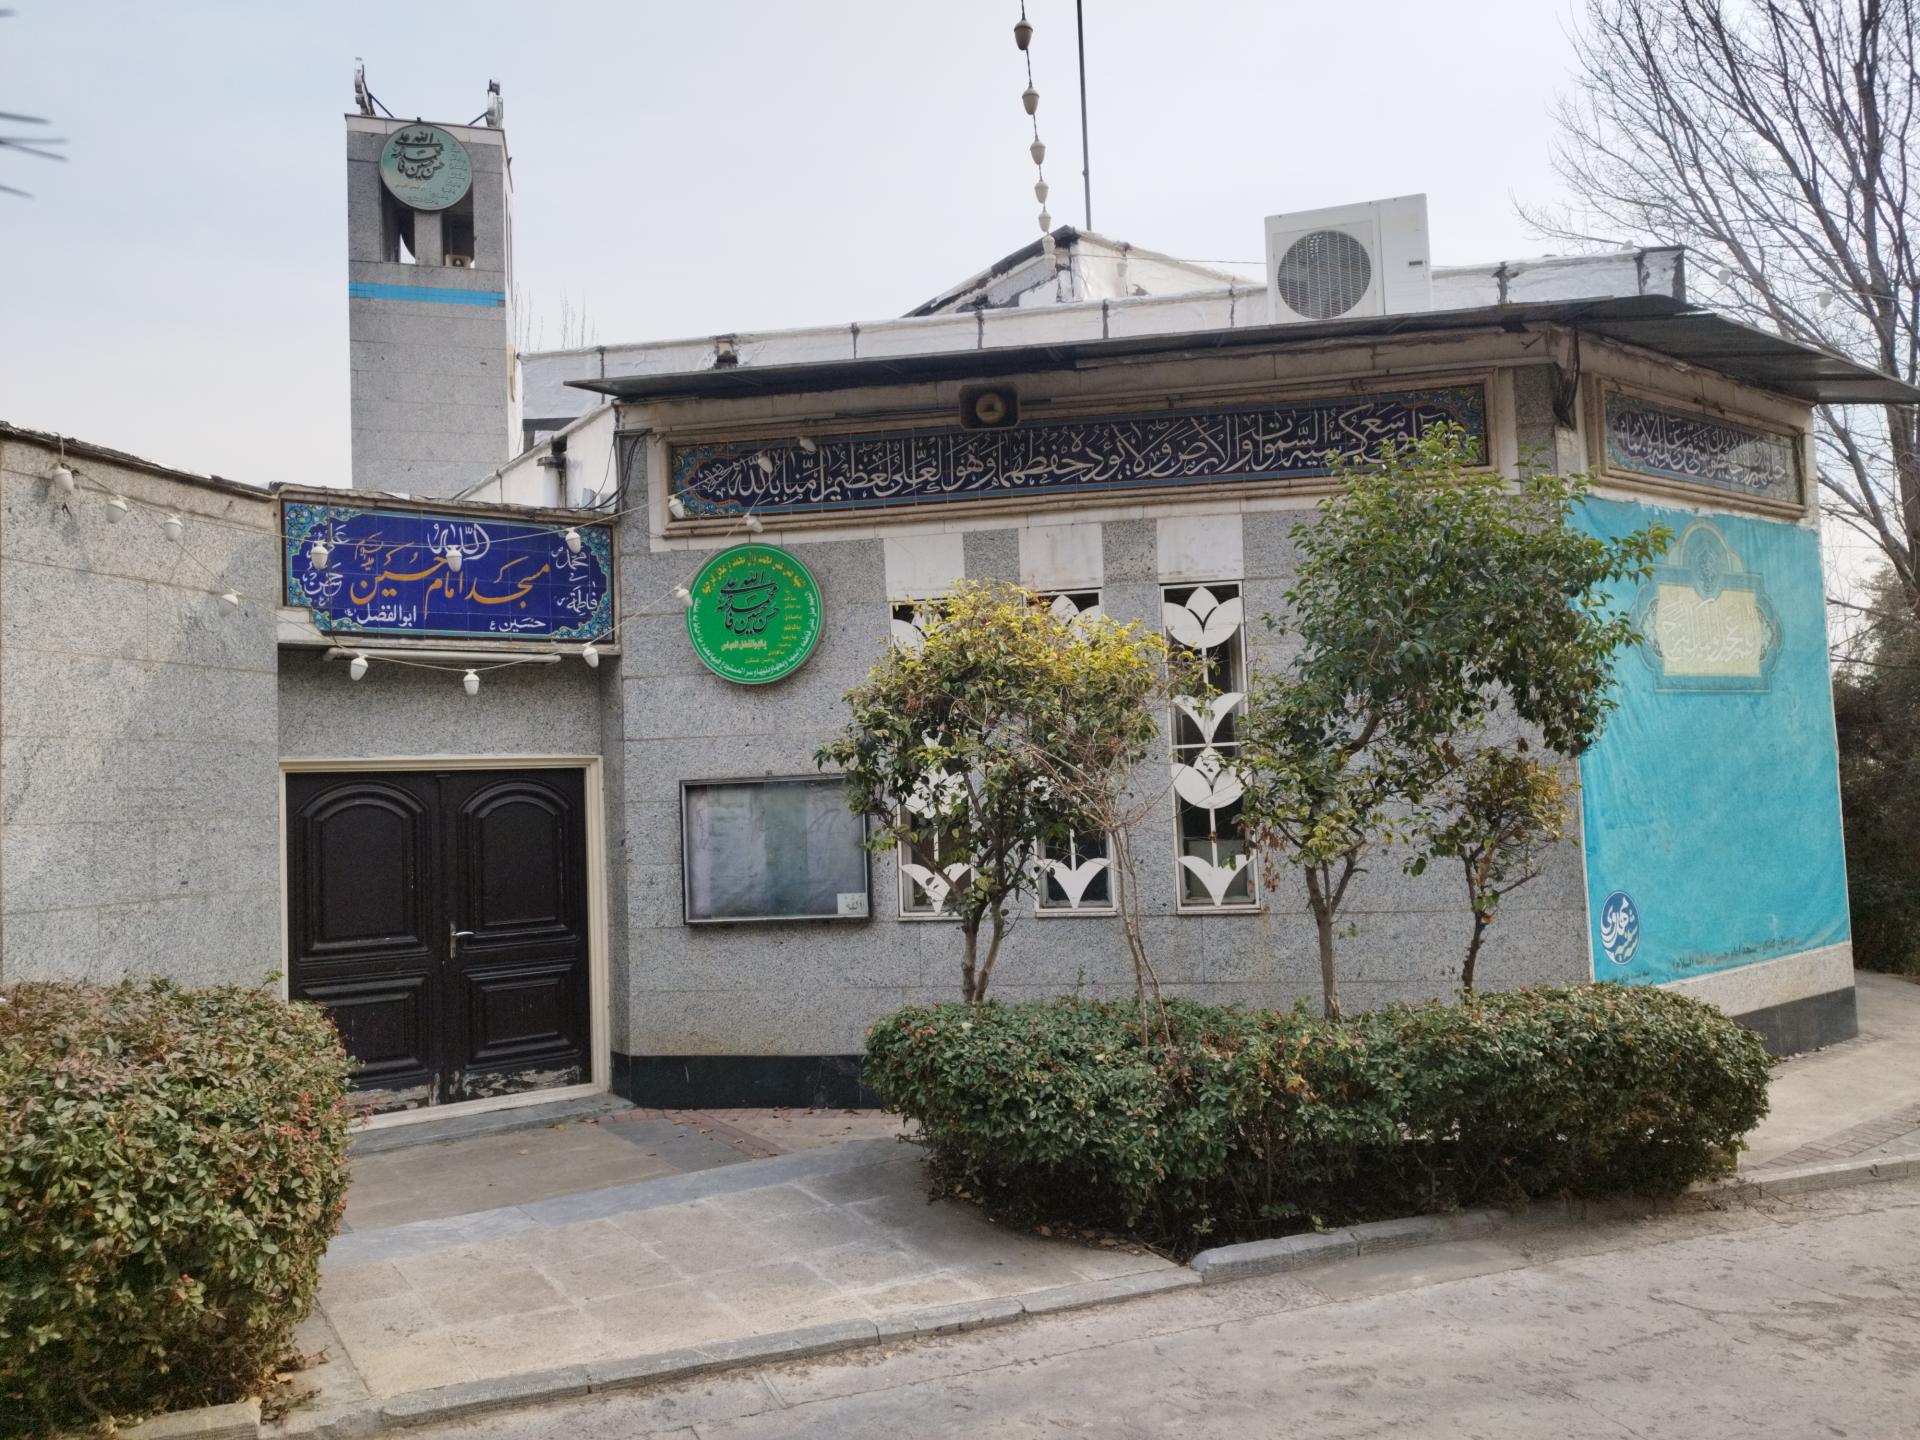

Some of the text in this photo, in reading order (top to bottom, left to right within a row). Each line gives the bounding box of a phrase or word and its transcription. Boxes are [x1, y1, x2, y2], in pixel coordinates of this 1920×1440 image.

[350, 550, 450, 605] حسین
[424, 571, 463, 620] امام
[465, 563, 549, 608] مسجد
[357, 603, 417, 627] ابوالفضل
[499, 617, 547, 632] حسین
